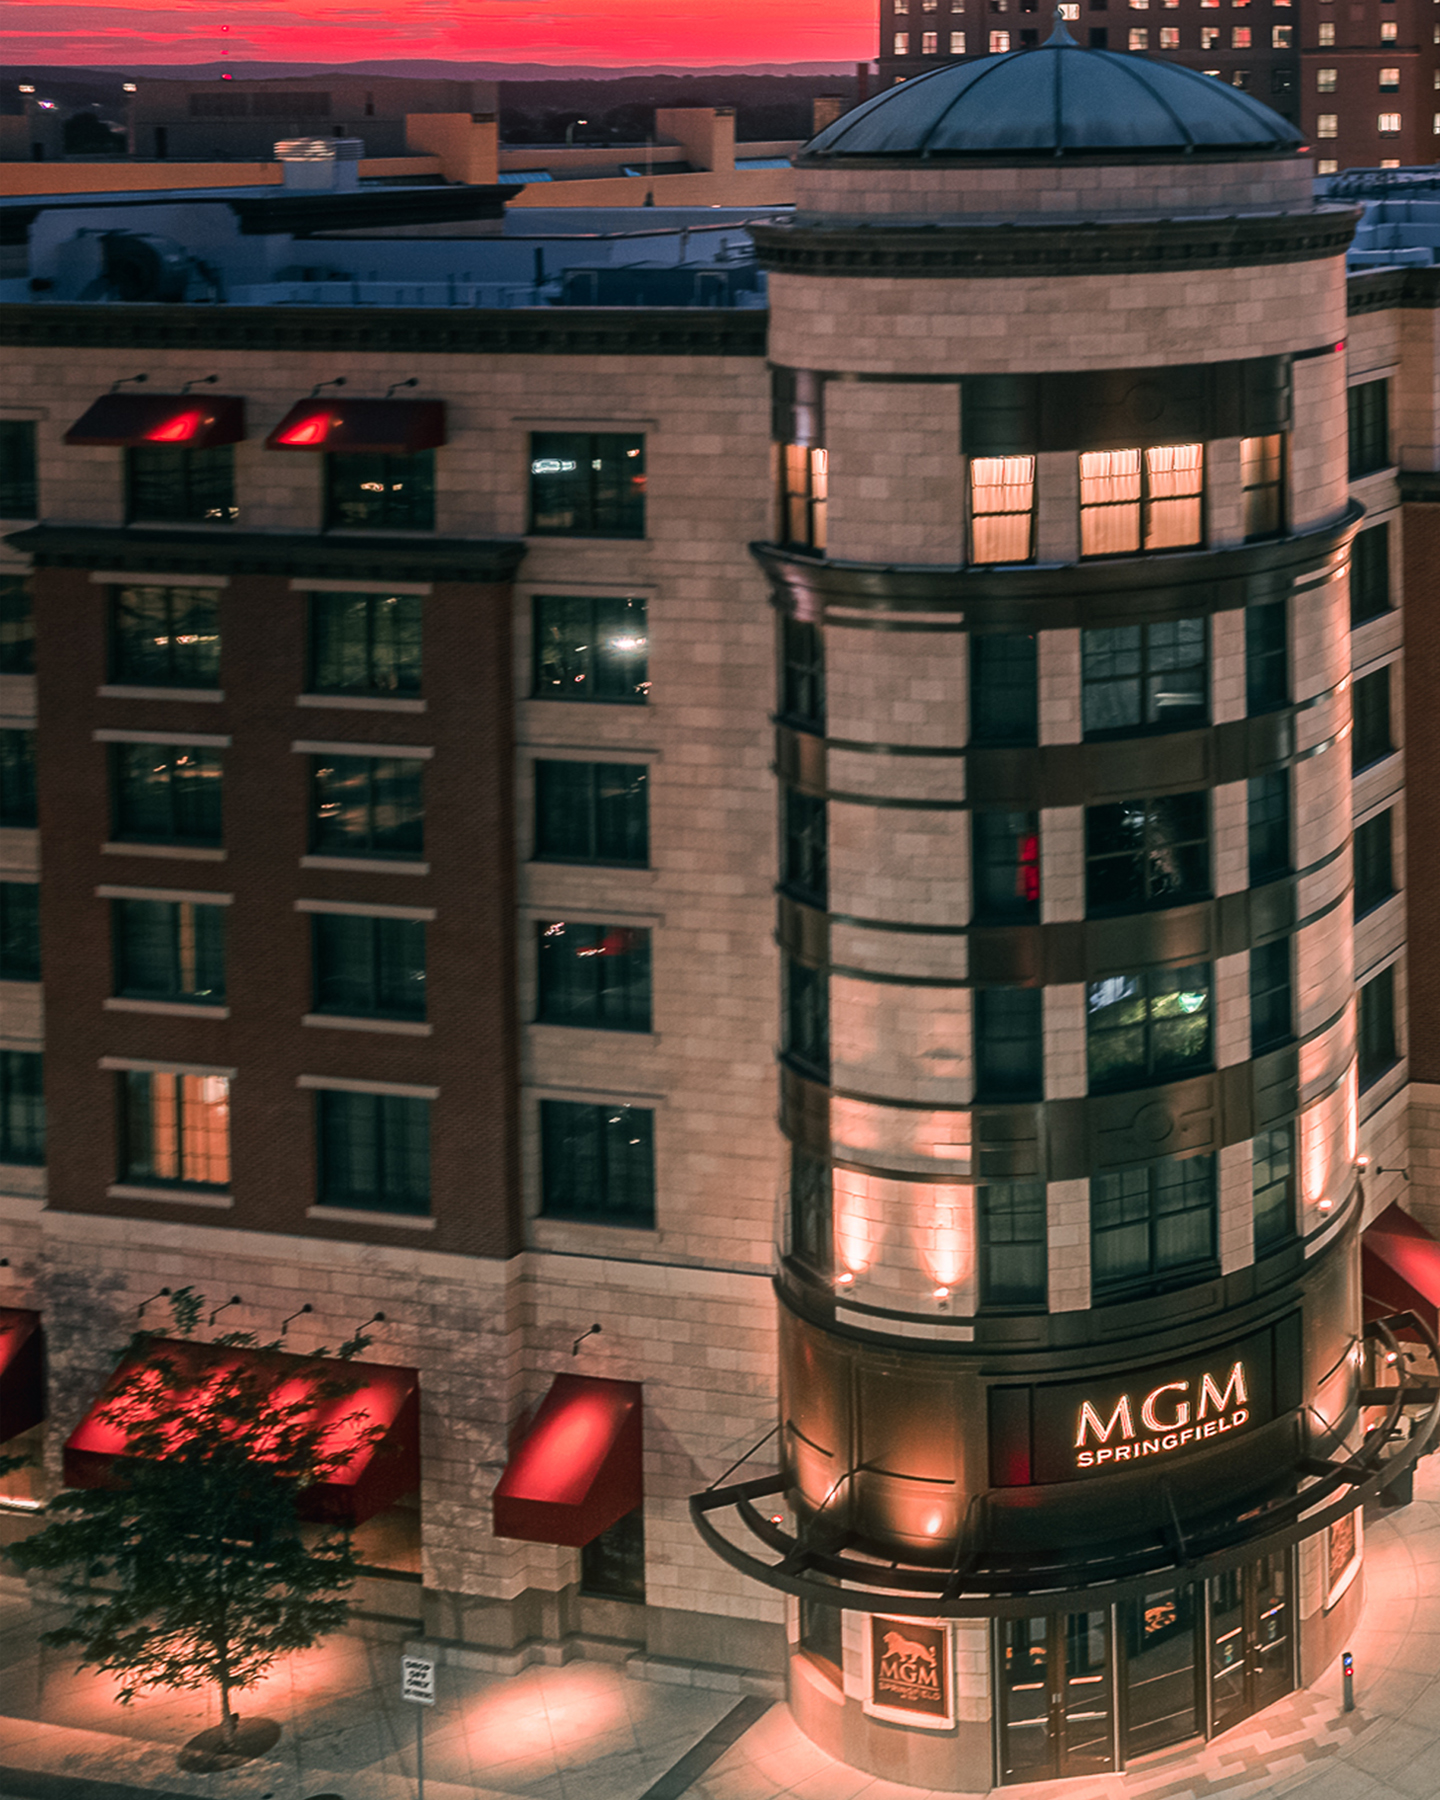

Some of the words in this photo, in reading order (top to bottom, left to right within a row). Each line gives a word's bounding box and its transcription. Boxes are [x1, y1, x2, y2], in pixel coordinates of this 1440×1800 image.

[1074, 1361, 1249, 1449] MGM
[1077, 1408, 1250, 1468] SPRINGFIELD
[879, 1660, 939, 1688] MGM
